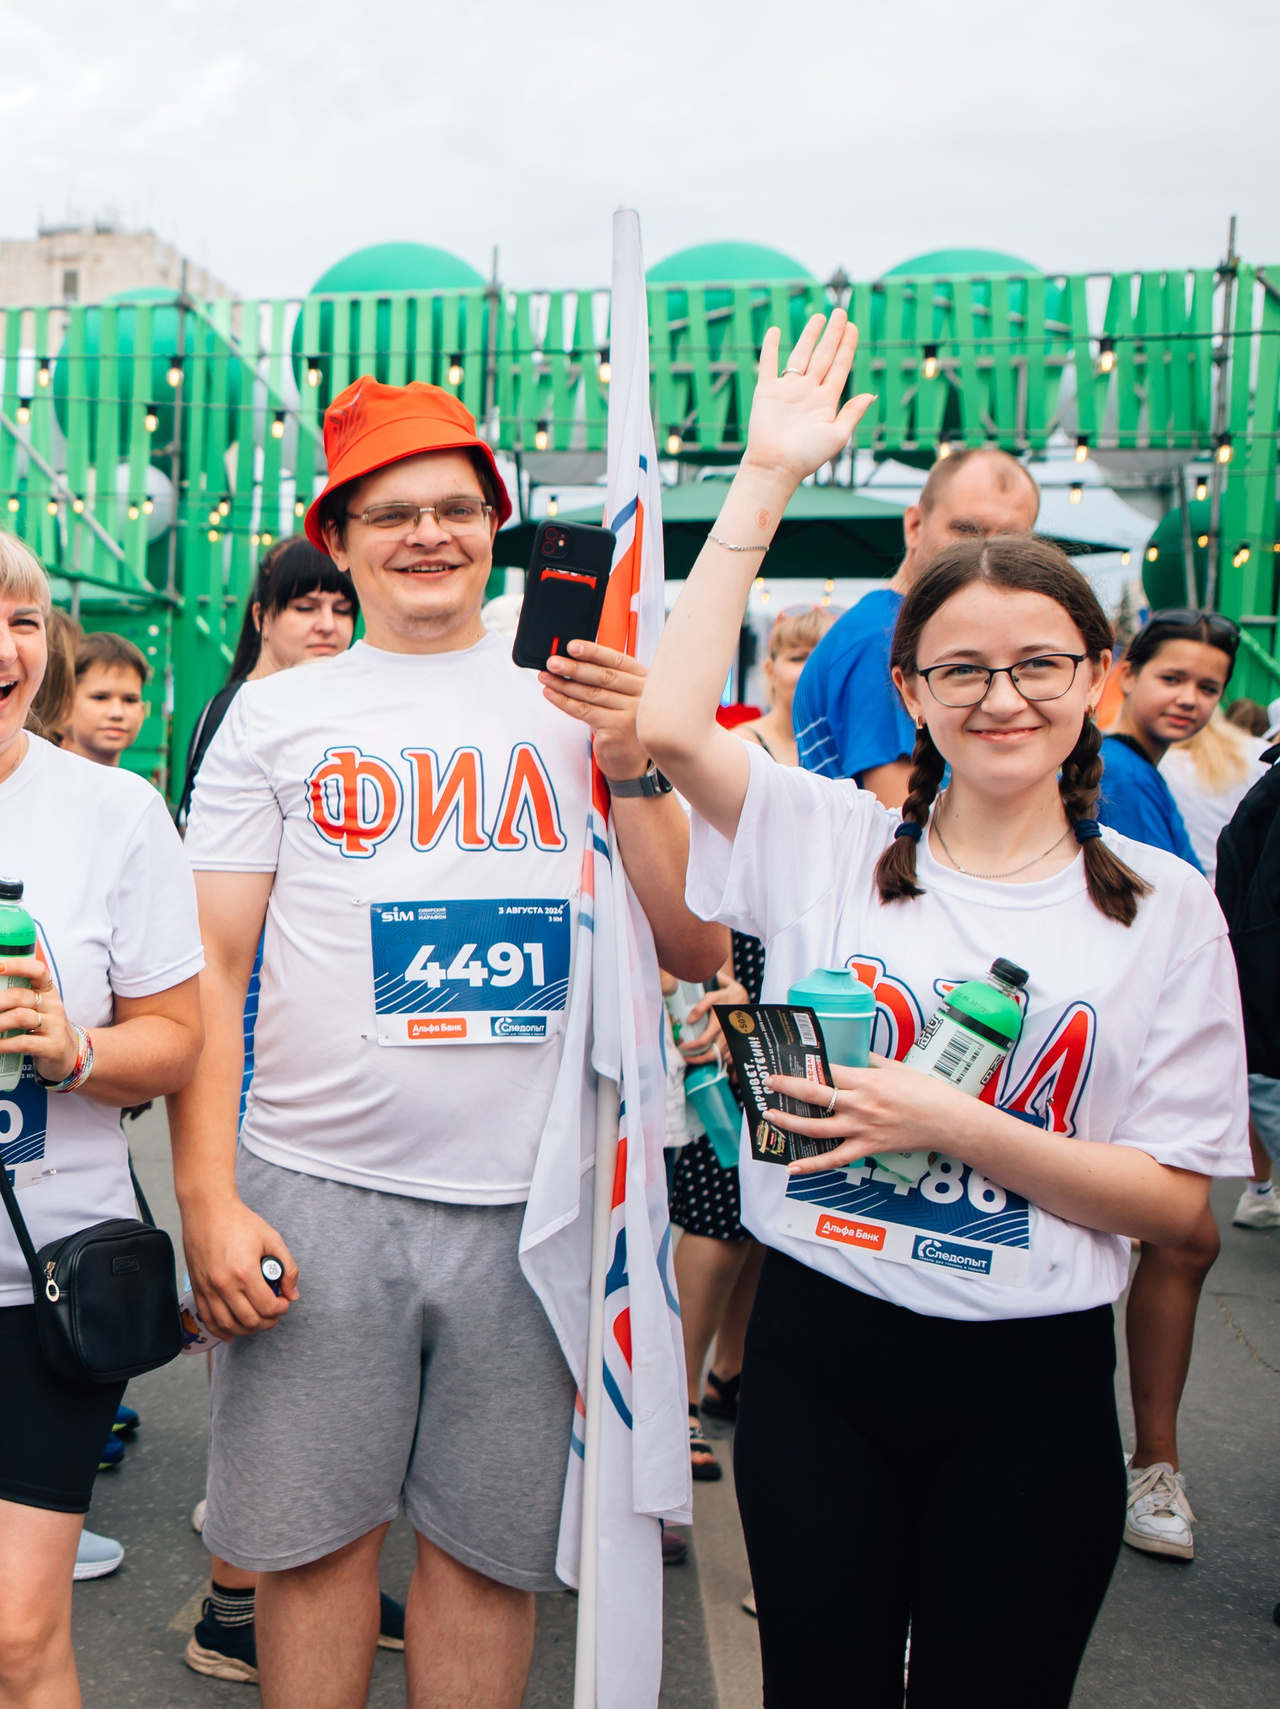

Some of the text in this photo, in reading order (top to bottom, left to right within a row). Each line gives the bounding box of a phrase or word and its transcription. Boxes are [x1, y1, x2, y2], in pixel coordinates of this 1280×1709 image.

[304, 742, 568, 859] ФИЛ
[498, 906, 563, 915] 3 АВГУСТА 2024
[404, 942, 545, 988] 4491
[412, 1023, 463, 1034] Альфа Банк
[500, 1023, 545, 1033] Следопыт
[734, 1011, 748, 1033] -50%
[822, 1221, 880, 1243] Альфа Банк
[925, 1247, 988, 1268] Следопыт
